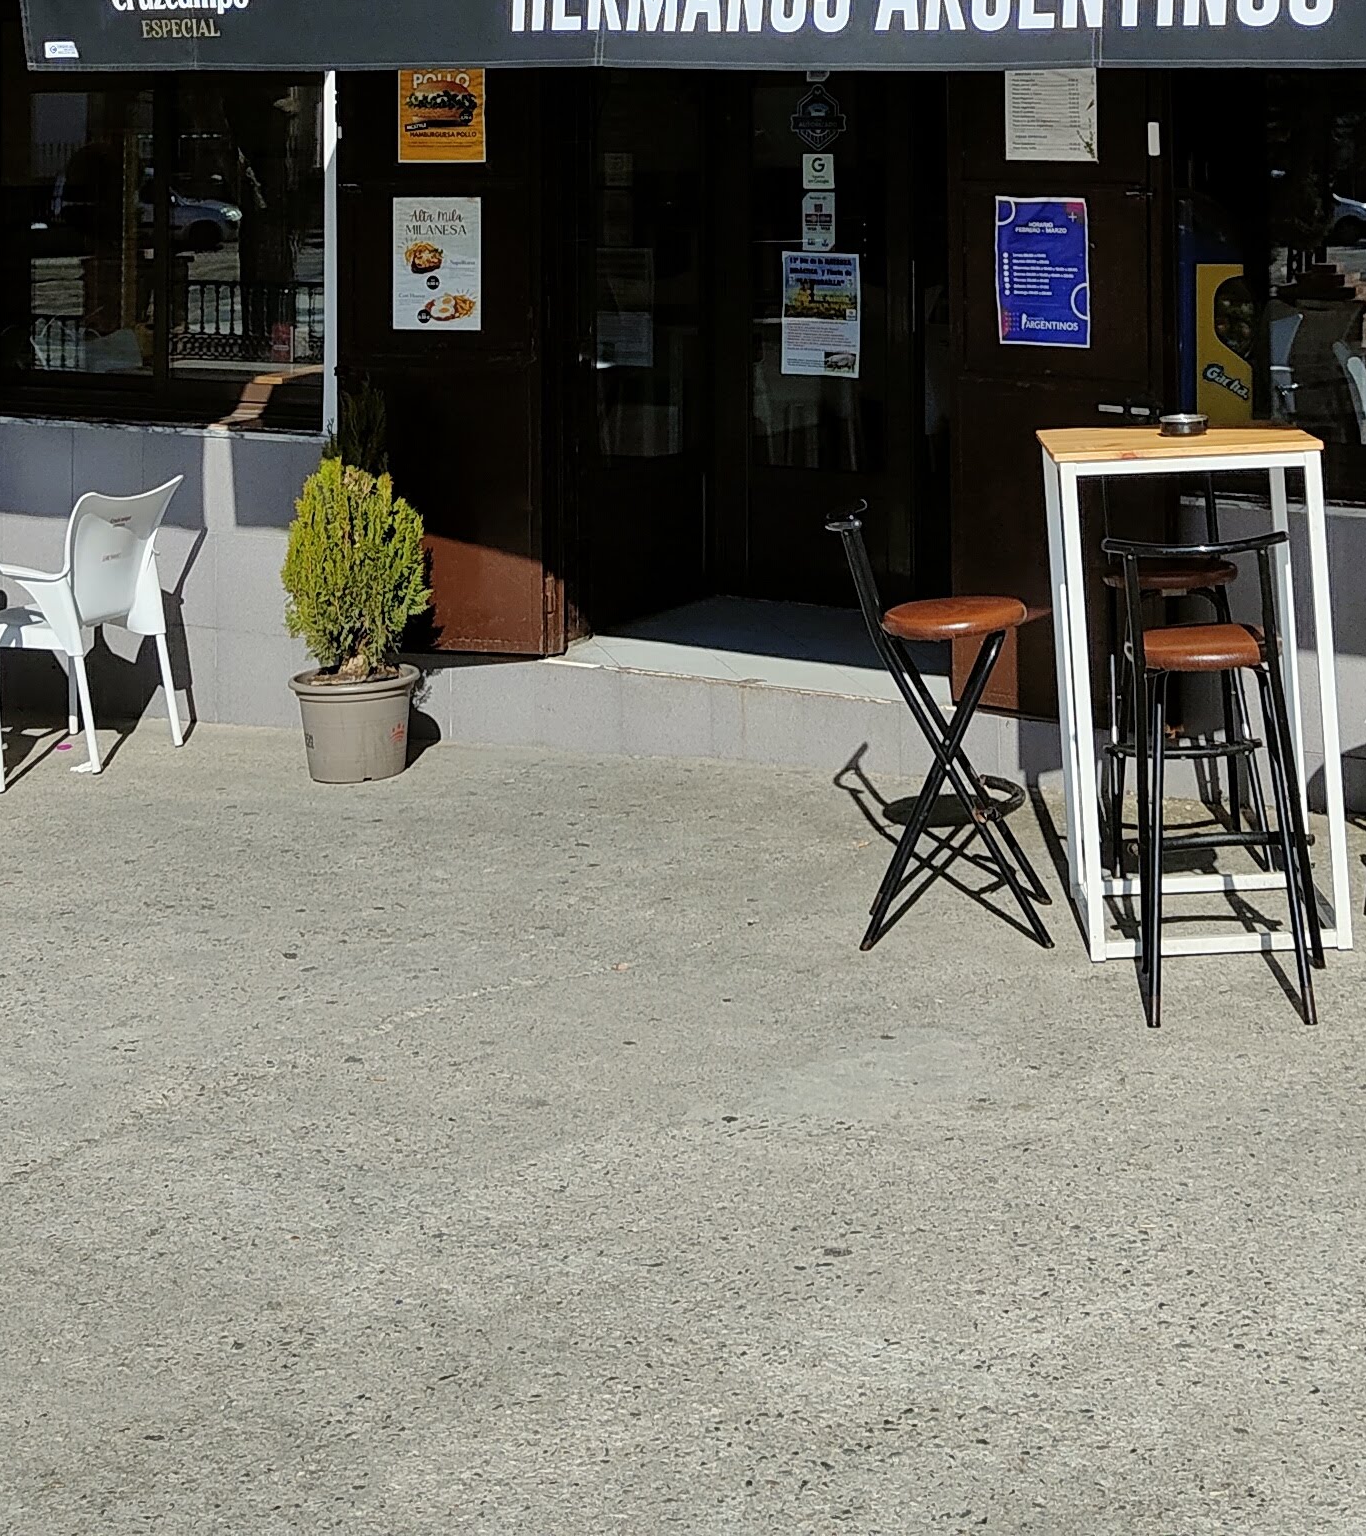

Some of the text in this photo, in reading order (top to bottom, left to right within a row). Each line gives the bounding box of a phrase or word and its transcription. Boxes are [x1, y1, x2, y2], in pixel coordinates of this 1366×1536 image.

[141, 18, 221, 38] ESPECIAL
[409, 209, 434, 223] Alta
[405, 225, 467, 236] MILANESA
[1026, 321, 1079, 331] ARGENTINOS
